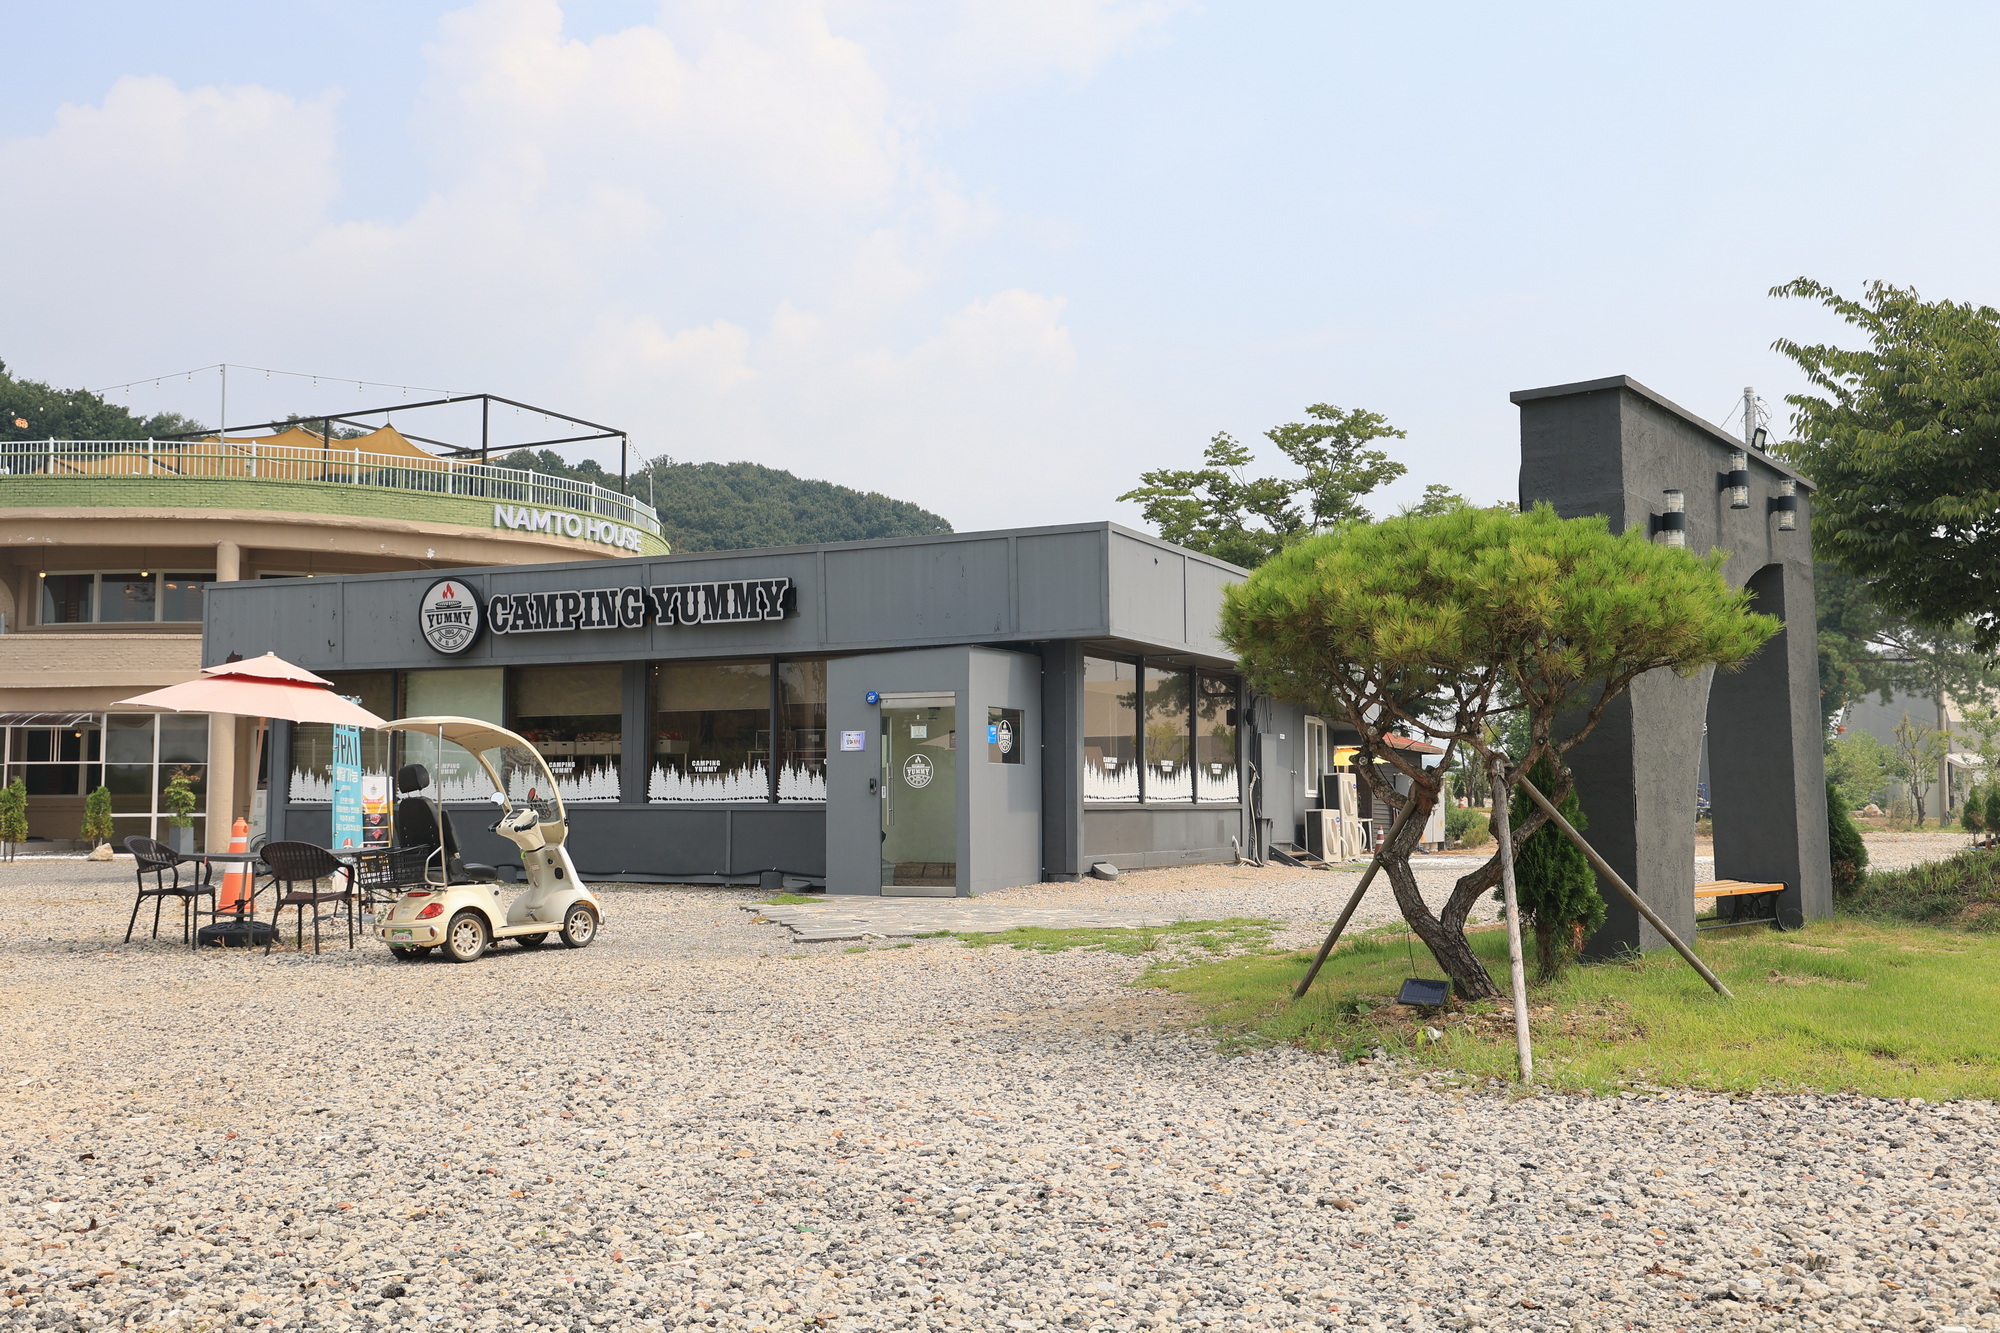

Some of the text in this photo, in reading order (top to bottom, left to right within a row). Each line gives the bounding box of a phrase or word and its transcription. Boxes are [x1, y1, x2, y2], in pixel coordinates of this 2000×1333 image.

[494, 504, 643, 552] NAMTO HOUSE
[427, 611, 472, 629] YUMMY
[487, 577, 794, 636] CAMPING YUMMY
[907, 768, 930, 777] YUMMY
